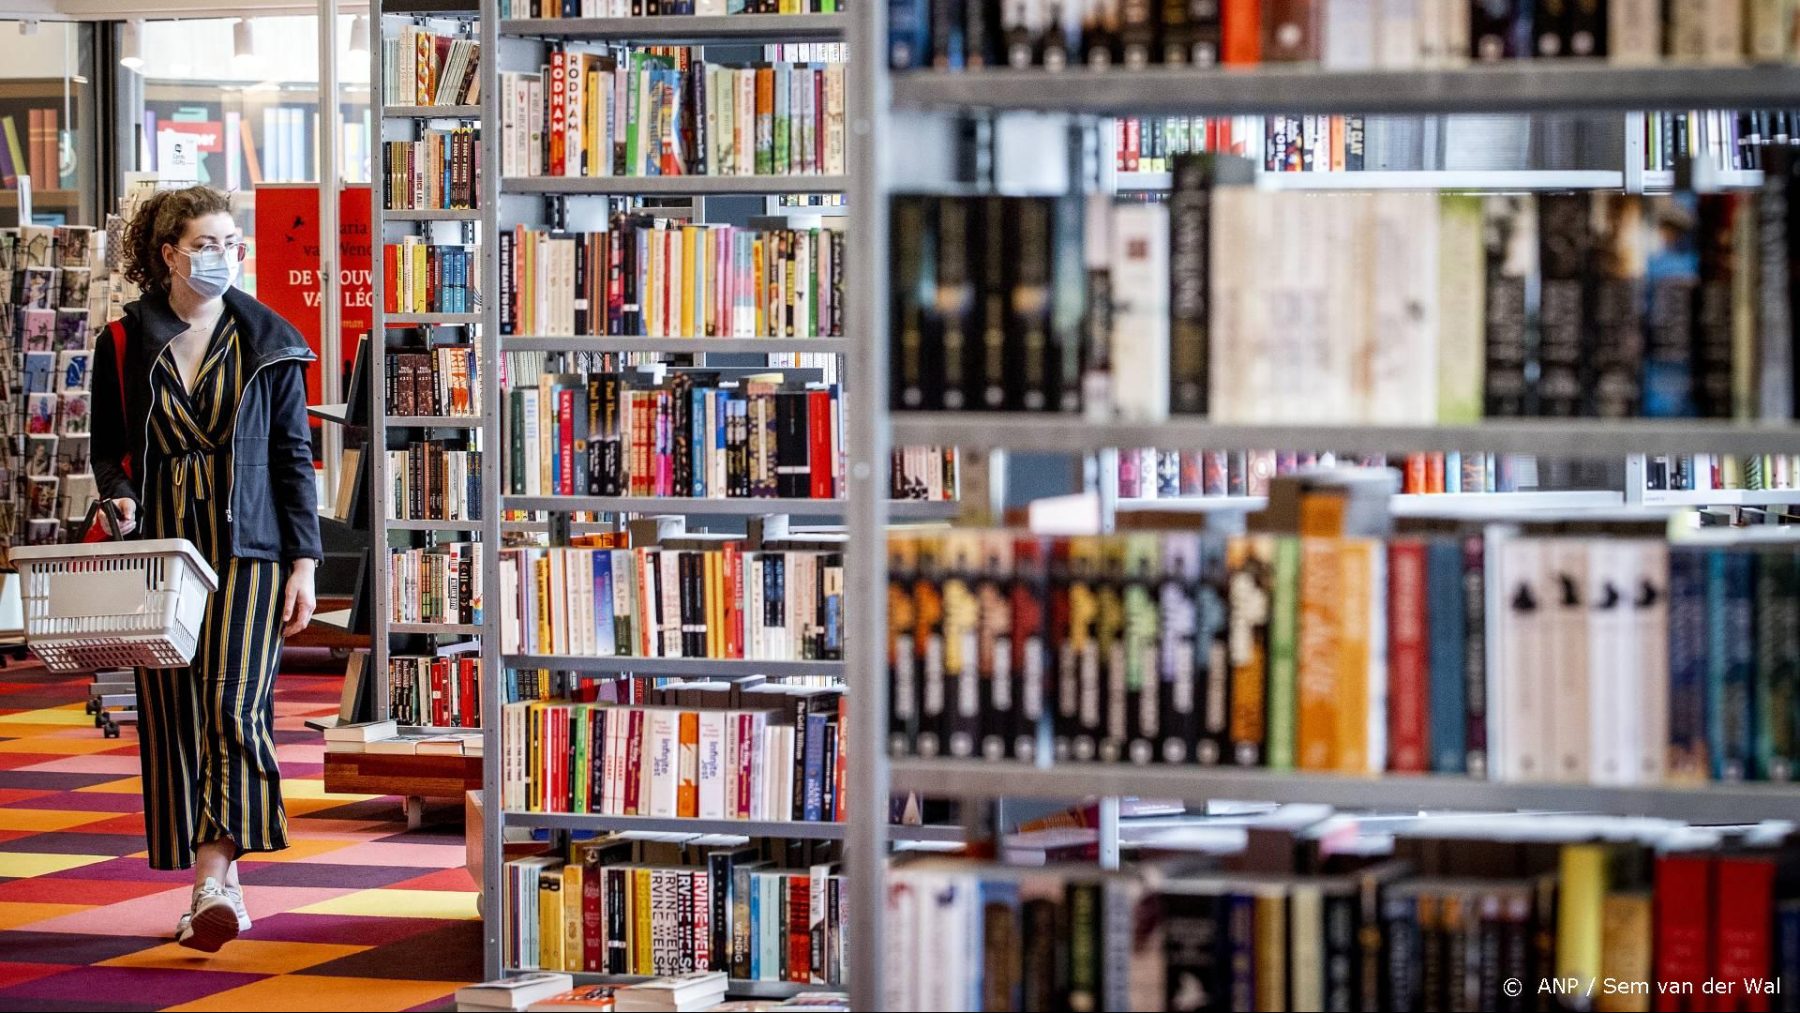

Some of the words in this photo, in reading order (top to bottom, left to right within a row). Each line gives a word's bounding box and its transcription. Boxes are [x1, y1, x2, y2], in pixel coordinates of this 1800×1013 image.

[552, 55, 563, 132] RODHAM
[568, 55, 579, 133] RODHAM
[340, 220, 367, 234] aria
[303, 245, 320, 256] va
[502, 251, 509, 264] MY
[289, 270, 312, 285] DE
[303, 292, 322, 306] VA
[502, 292, 509, 304] TO
[590, 381, 598, 400] Paul
[605, 381, 613, 400] Paul
[563, 394, 571, 420] KATE
[527, 422, 536, 439] LIFE
[563, 443, 571, 485] TEMPEST
[797, 702, 805, 713] The
[654, 757, 662, 776] Jest
[661, 738, 670, 774] Infinite
[709, 741, 718, 777] Infinite
[702, 760, 710, 780] Jest
[652, 871, 663, 920] IRVINE
[665, 871, 676, 920] IRVINE
[679, 872, 691, 922] IRVINE
[694, 872, 707, 923] IRVINE
[654, 925, 665, 976] WELSH
[667, 925, 677, 976] WELSH
[735, 921, 743, 963] WENDIG
